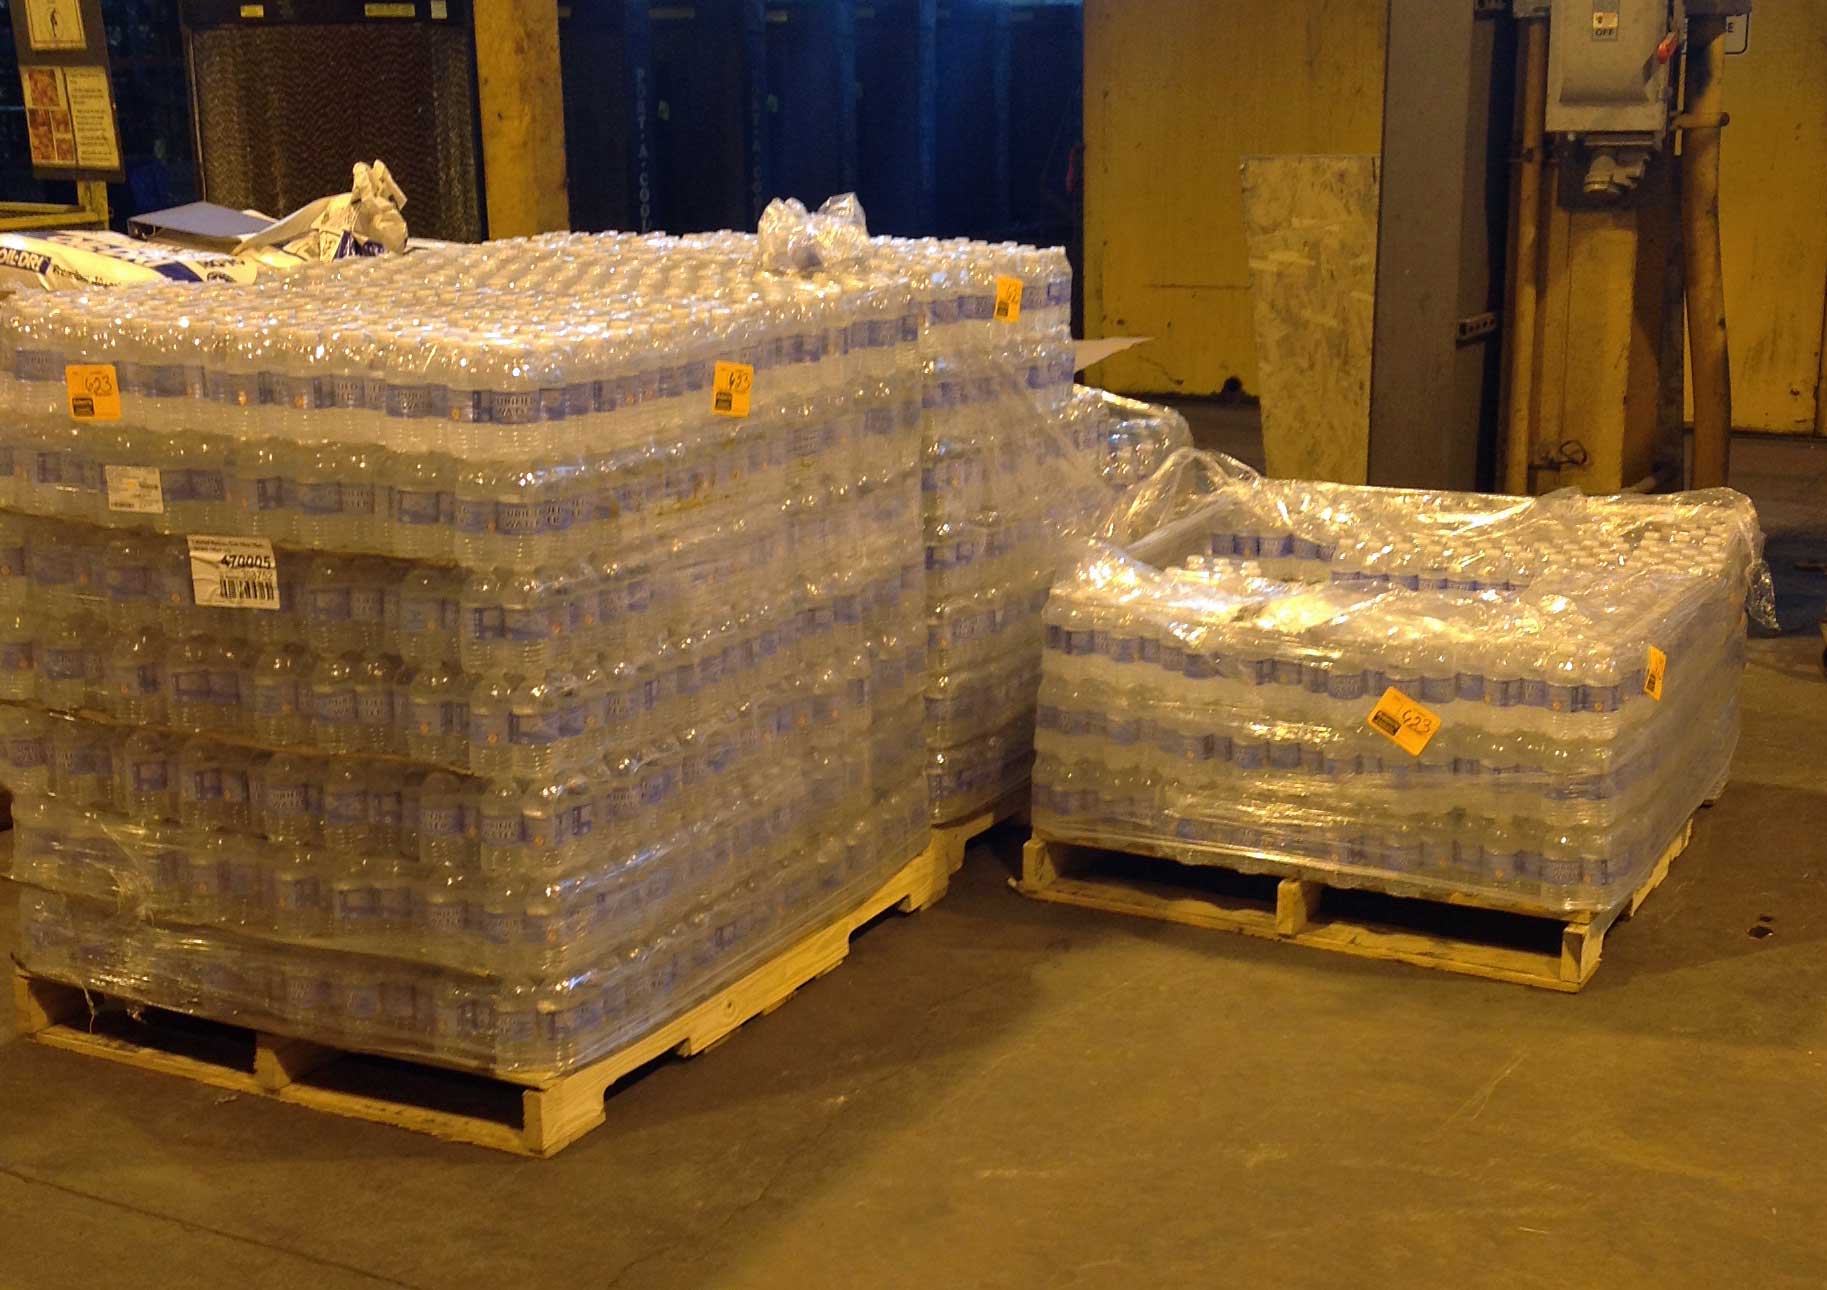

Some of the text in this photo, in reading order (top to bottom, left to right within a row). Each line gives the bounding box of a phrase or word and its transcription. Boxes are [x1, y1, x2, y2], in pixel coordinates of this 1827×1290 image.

[1595, 29, 1614, 37] OFF
[85, 375, 113, 396] 623
[220, 554, 271, 570] 470005
[1402, 710, 1432, 735] 623
